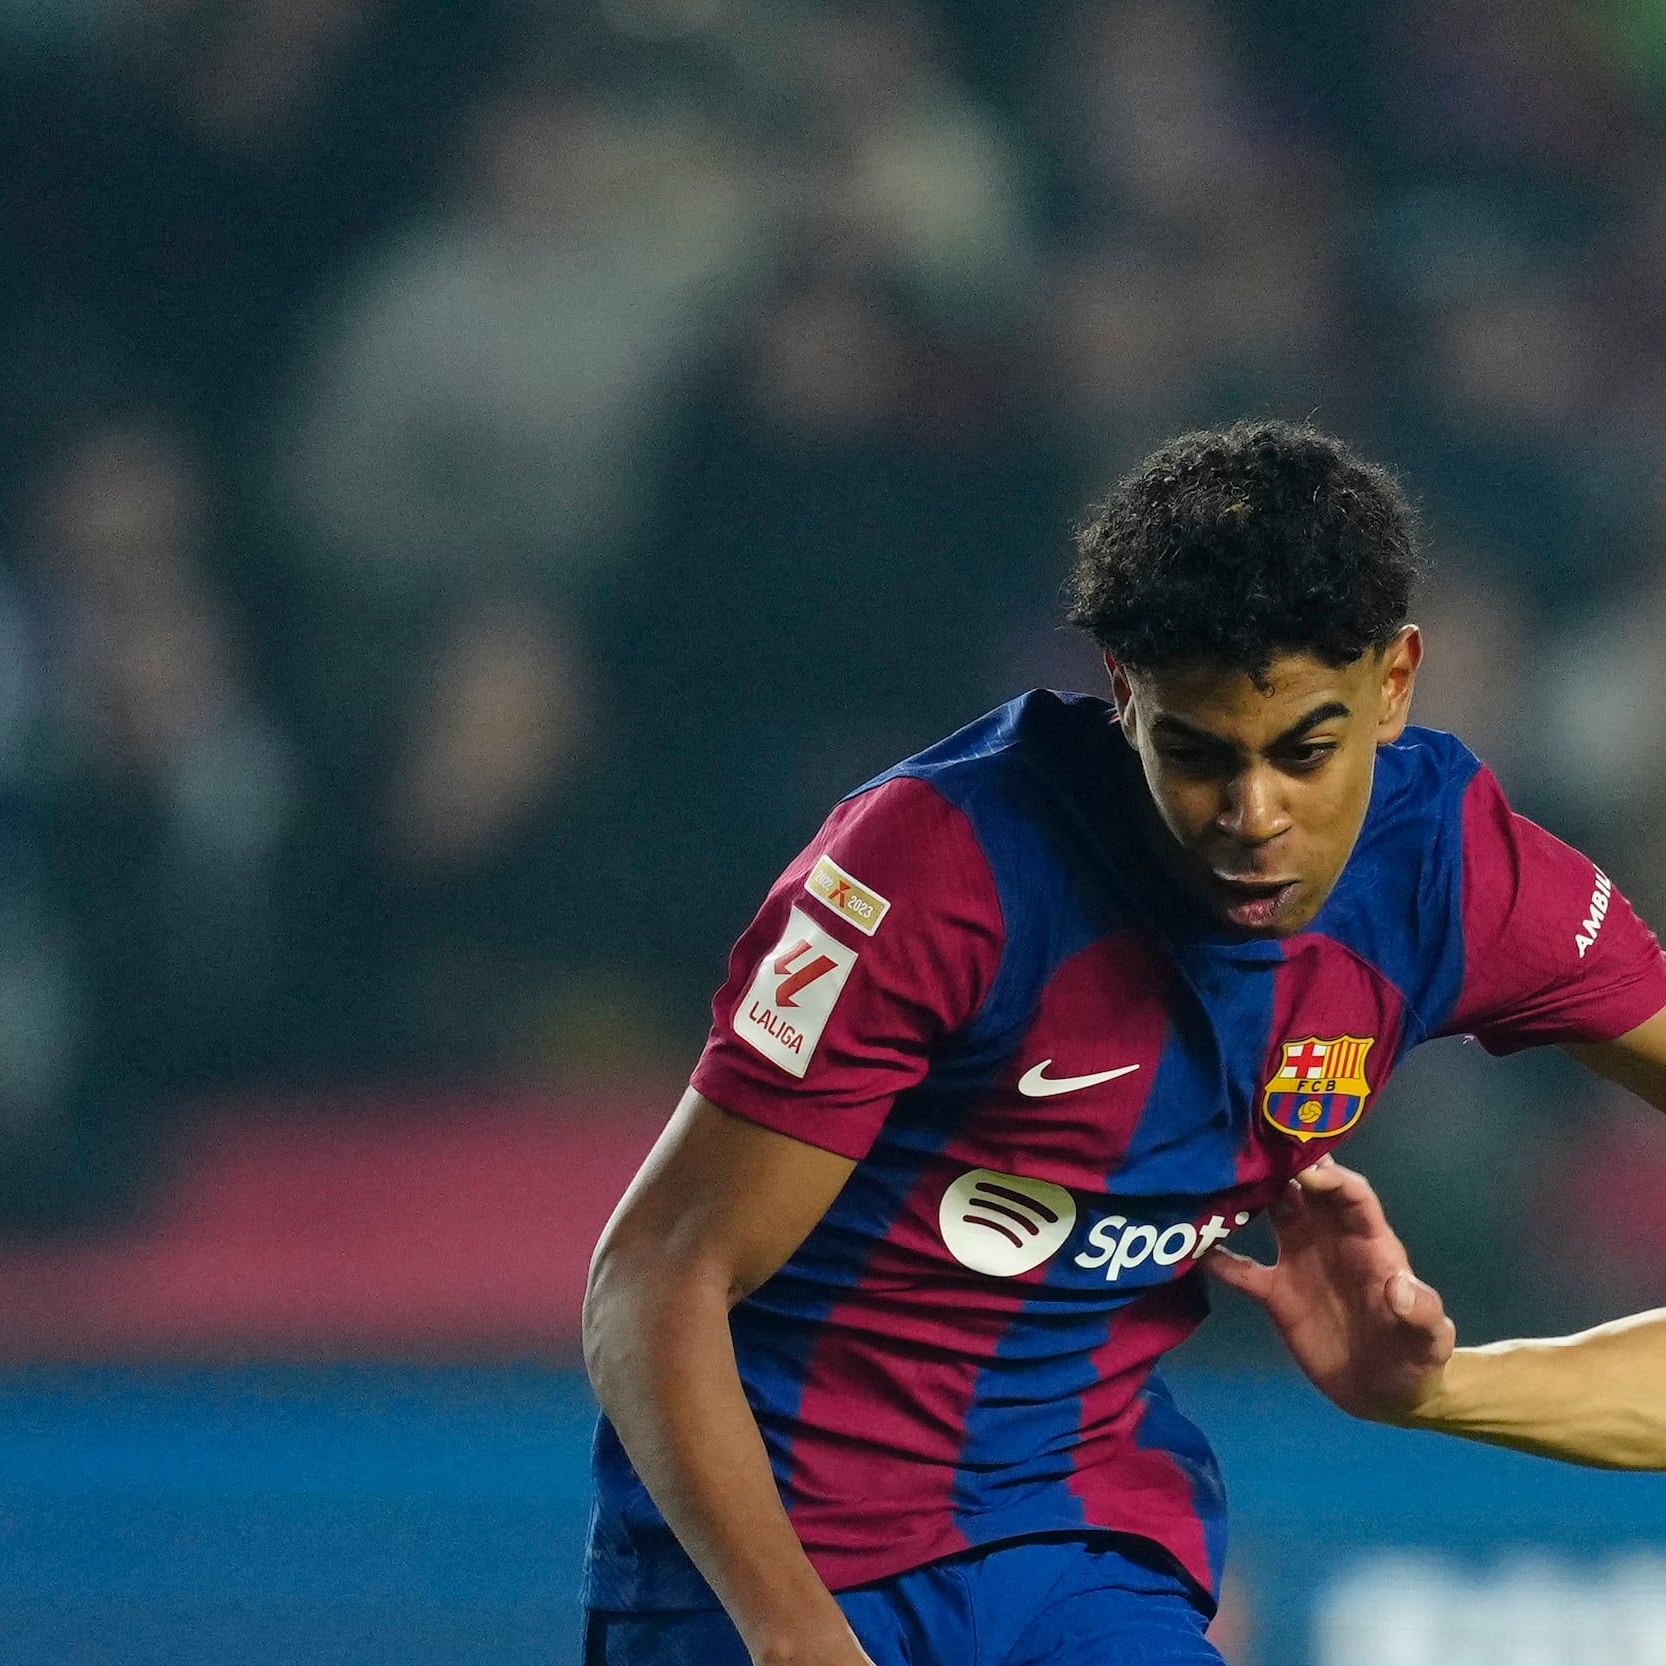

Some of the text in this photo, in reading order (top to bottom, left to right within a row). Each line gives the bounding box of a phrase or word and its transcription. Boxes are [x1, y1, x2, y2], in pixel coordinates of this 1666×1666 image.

[847, 894, 875, 919] 2023
[1574, 864, 1612, 959] AMBIL
[748, 1000, 805, 1055] LALIGA
[1296, 1080, 1336, 1092] FCB
[1074, 1210, 1250, 1281] Spot
